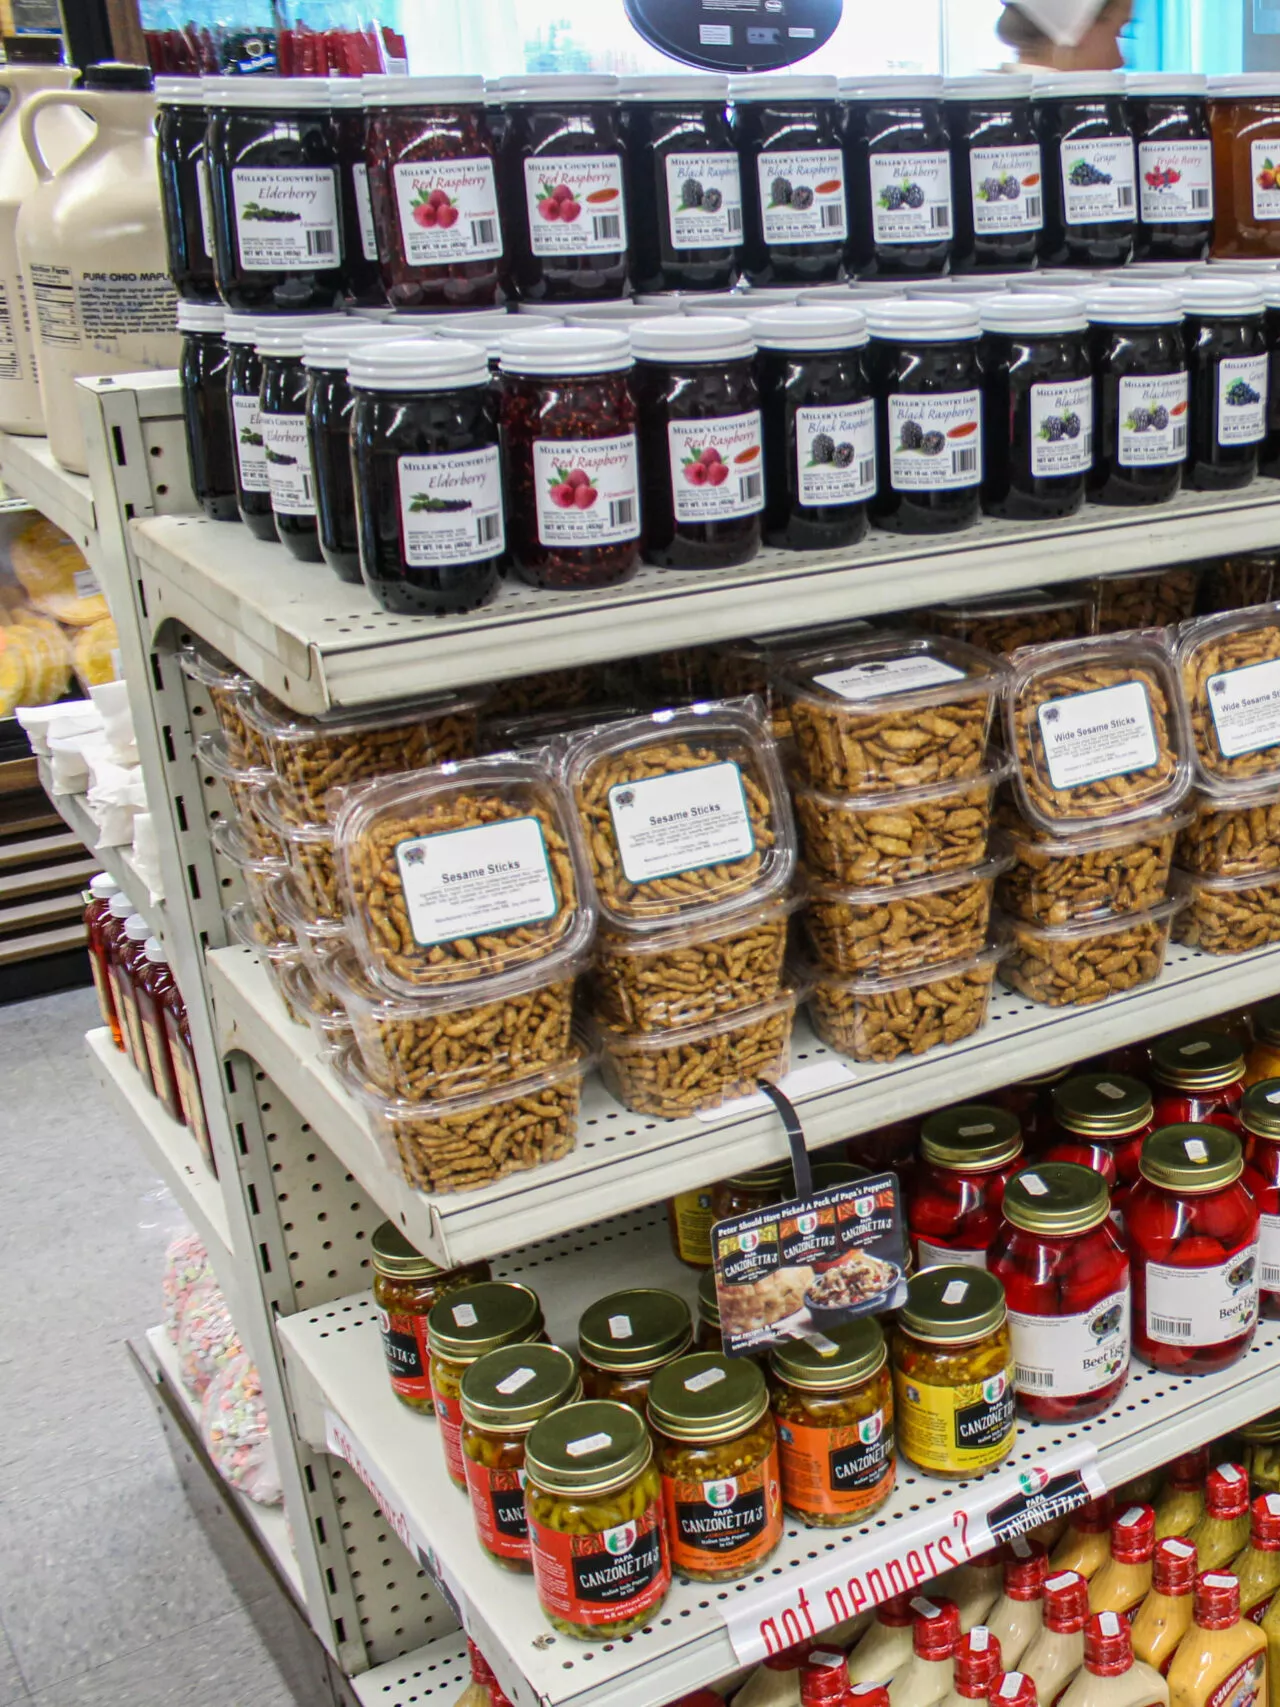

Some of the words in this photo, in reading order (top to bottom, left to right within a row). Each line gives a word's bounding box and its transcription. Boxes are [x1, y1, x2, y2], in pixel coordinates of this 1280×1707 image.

[991, 158, 1033, 171] Blackberry
[1093, 152, 1117, 164] Grape
[1180, 156, 1203, 166] Berry
[400, 167, 437, 177] MILLER'S
[439, 165, 475, 175] COUNTRY
[528, 162, 563, 171] MILLER'S
[564, 162, 600, 171] COUNTRY
[677, 166, 704, 178] Black
[767, 165, 794, 176] Black
[795, 164, 838, 178] Raspberry
[892, 166, 939, 179] Blackberry
[236, 174, 274, 183] MILLER'S
[275, 174, 314, 183] COUNTRY
[411, 177, 434, 190] Red
[435, 174, 487, 191] Raspberry
[537, 172, 560, 184] Red
[561, 172, 611, 185] Raspberry
[258, 186, 317, 203] Elderberry
[83, 272, 107, 280] PURE
[109, 272, 137, 282] OHIO
[139, 273, 172, 281] MAPL
[1142, 386, 1183, 400] Blackberry
[801, 411, 838, 420] MILLER'S
[897, 408, 926, 420] Black
[928, 407, 975, 422] Raspberry
[672, 423, 711, 435] MILLER'S
[712, 420, 746, 433] COUNTRY
[808, 421, 837, 434] Black
[684, 434, 706, 448] Red
[708, 430, 756, 447] Raspberry
[539, 445, 580, 454] MILLER'S
[581, 442, 618, 453] COUNTRY
[403, 460, 446, 472] MILLER'S
[447, 457, 483, 470] COUNTRY
[551, 455, 574, 468] Red
[577, 452, 630, 471] Raspberry
[428, 471, 488, 489] Elderberry
[1221, 701, 1241, 713] Wide
[1243, 695, 1271, 709] Sesame
[1054, 730, 1074, 743] Wide
[1077, 722, 1109, 739] Sesame
[1110, 715, 1136, 731] Sticks
[649, 810, 688, 826] Sesame
[690, 802, 721, 819] Sticks
[442, 866, 485, 884] Sesame
[487, 860, 520, 876] Sticks
[718, 1225, 737, 1237] Peter
[738, 1217, 762, 1230] Should
[764, 1212, 781, 1224] Have
[782, 1204, 805, 1218] Picked
[806, 1202, 812, 1210] A
[813, 1198, 830, 1208] Peck
[831, 1194, 839, 1203] of
[840, 1188, 862, 1200] Papa's
[863, 1179, 892, 1194] Peppers!
[841, 1218, 893, 1242] CANZONETTA'S
[783, 1235, 836, 1260] CANZONETTA'S
[725, 1252, 778, 1277] CANZONETTA'S
[1219, 1302, 1243, 1319] Beet
[1083, 1353, 1109, 1370] Beet
[989, 1401, 1003, 1412] PAPA
[865, 1442, 880, 1454] PAPA
[1025, 1491, 1048, 1506] PAPA
[498, 1508, 527, 1523] CANZ
[681, 1505, 763, 1533] CANZONETTA'S
[713, 1508, 733, 1516] PAPA
[999, 1491, 1088, 1542] CANZONETTA'S
[614, 1554, 634, 1565] PAPA
[579, 1546, 659, 1589] CANZONETTA'S
[1212, 1664, 1247, 1706] SANDWICH
